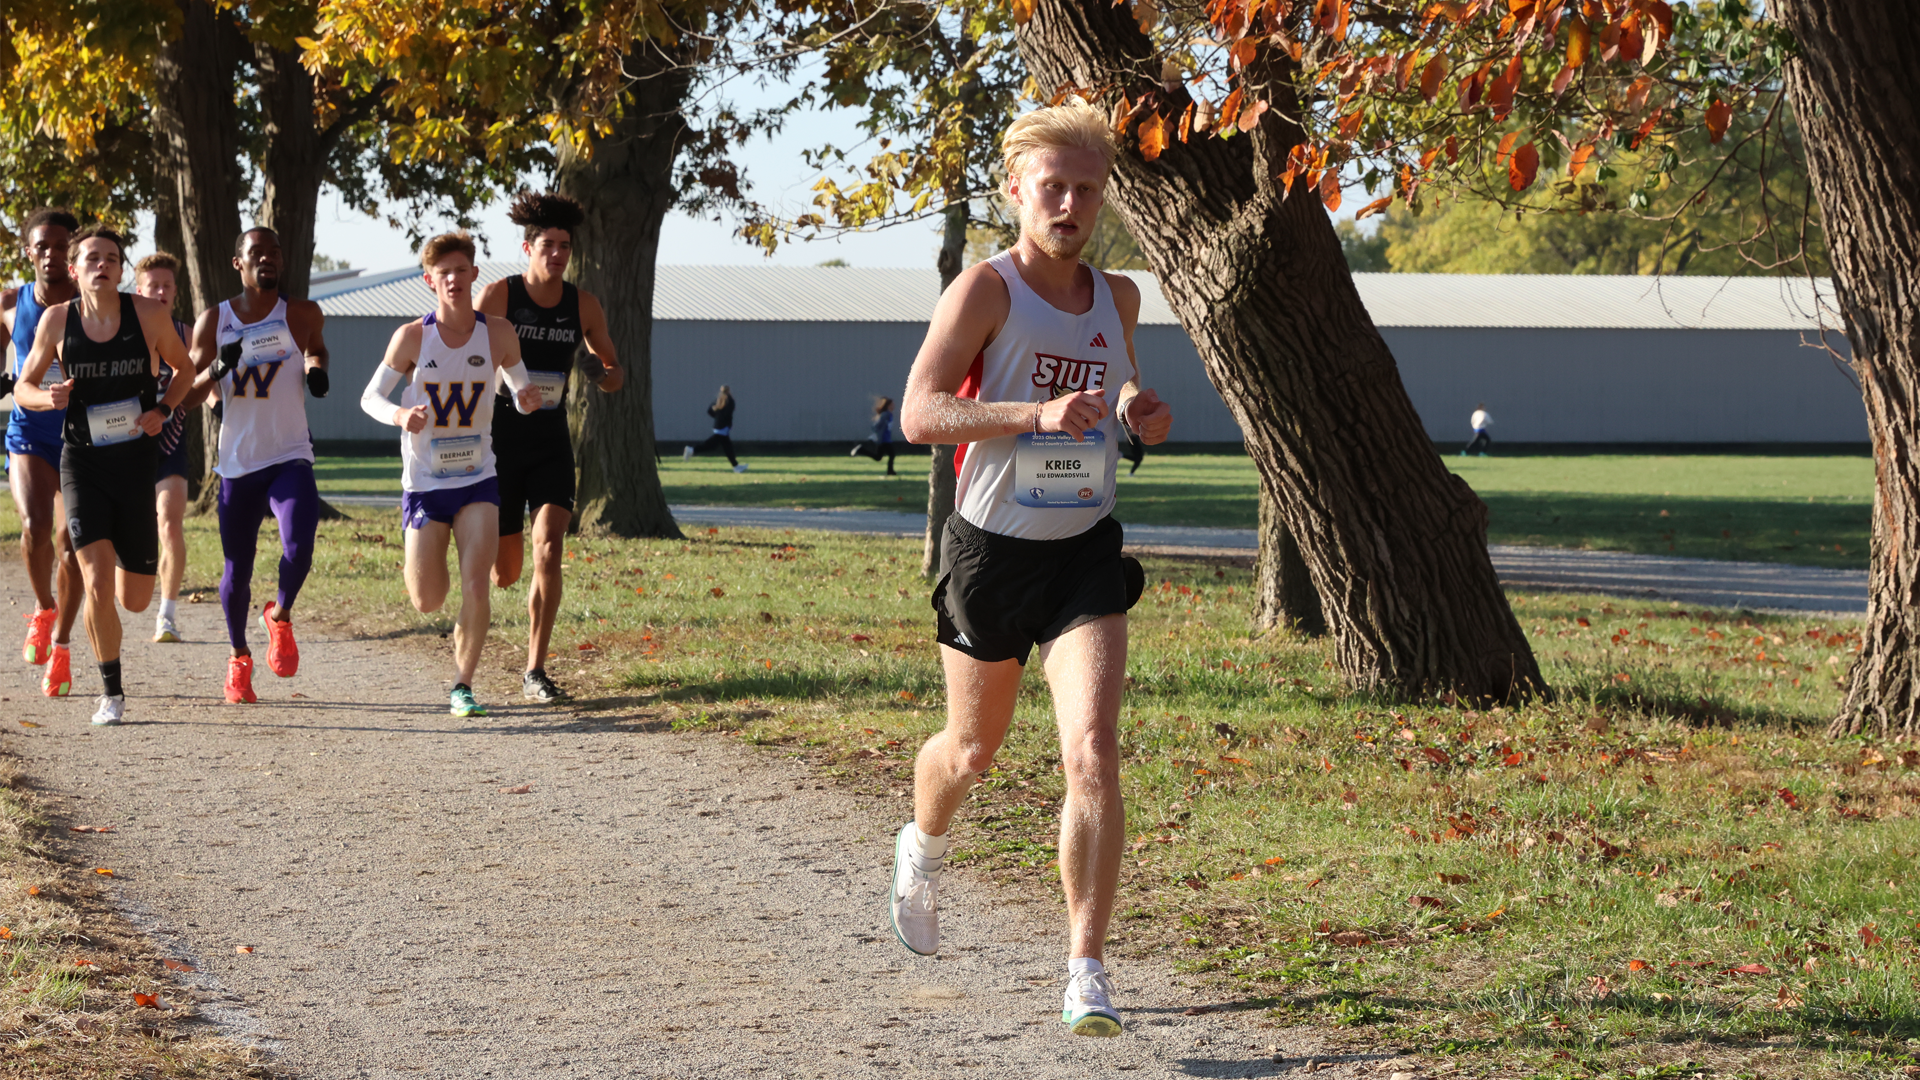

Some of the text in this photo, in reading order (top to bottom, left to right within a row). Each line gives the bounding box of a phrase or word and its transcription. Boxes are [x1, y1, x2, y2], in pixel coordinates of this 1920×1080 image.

[251, 335, 279, 346] BROWN
[547, 328, 576, 343] ROCK
[69, 358, 145, 378] LITTLE ROCK
[1033, 354, 1106, 390] SIUE
[231, 360, 284, 399] W
[423, 381, 486, 428] W
[105, 415, 126, 425] KING
[440, 450, 474, 460] EBERHART
[1045, 460, 1082, 470] KRIEG
